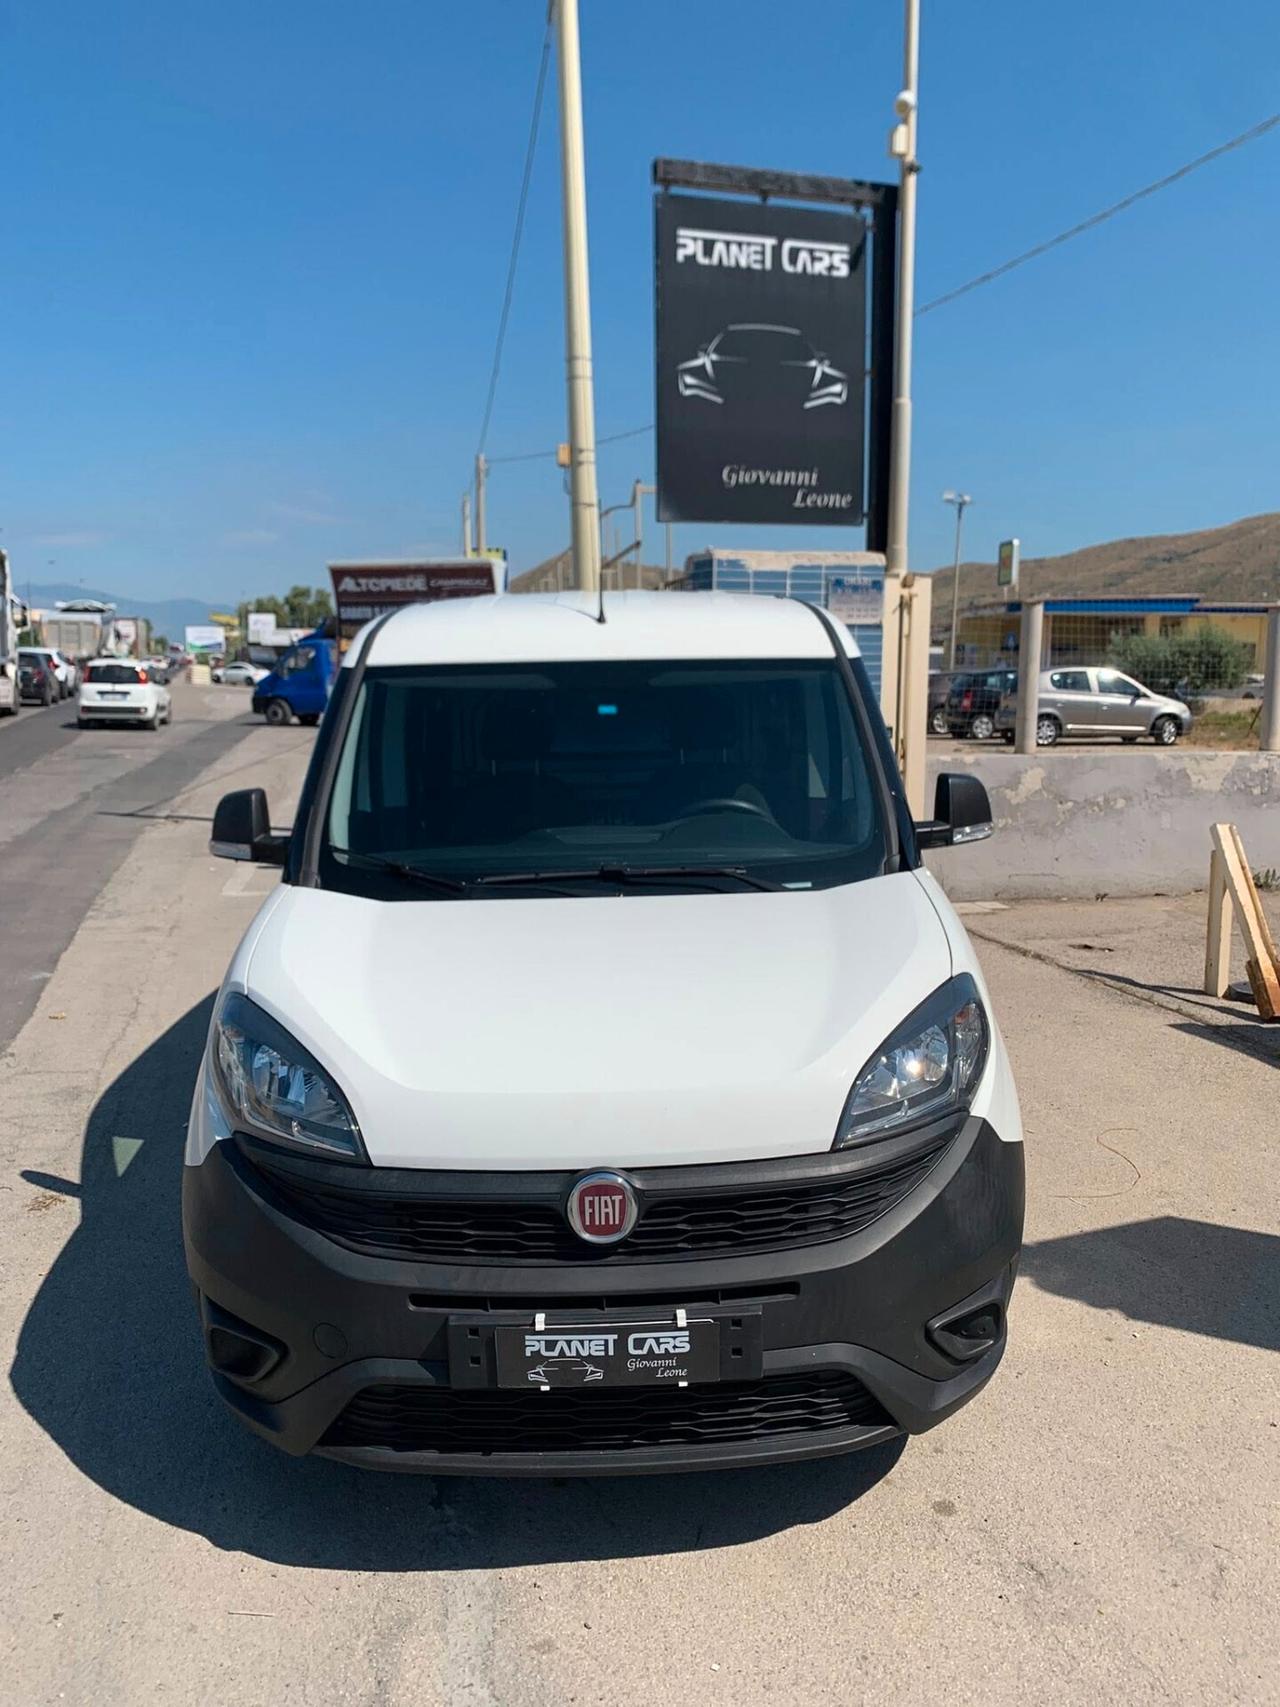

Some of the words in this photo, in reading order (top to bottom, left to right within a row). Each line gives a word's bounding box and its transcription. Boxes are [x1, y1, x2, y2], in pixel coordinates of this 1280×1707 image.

[676, 227, 778, 271] PLANET
[781, 238, 851, 278] CARS
[722, 464, 818, 488] Giovanni
[792, 487, 853, 509] Leone
[584, 1195, 623, 1226] FIAT
[524, 1334, 618, 1357] PLANET
[627, 1330, 691, 1355] CARS
[627, 1356, 677, 1371] Giovanni
[655, 1367, 688, 1378] Leone
